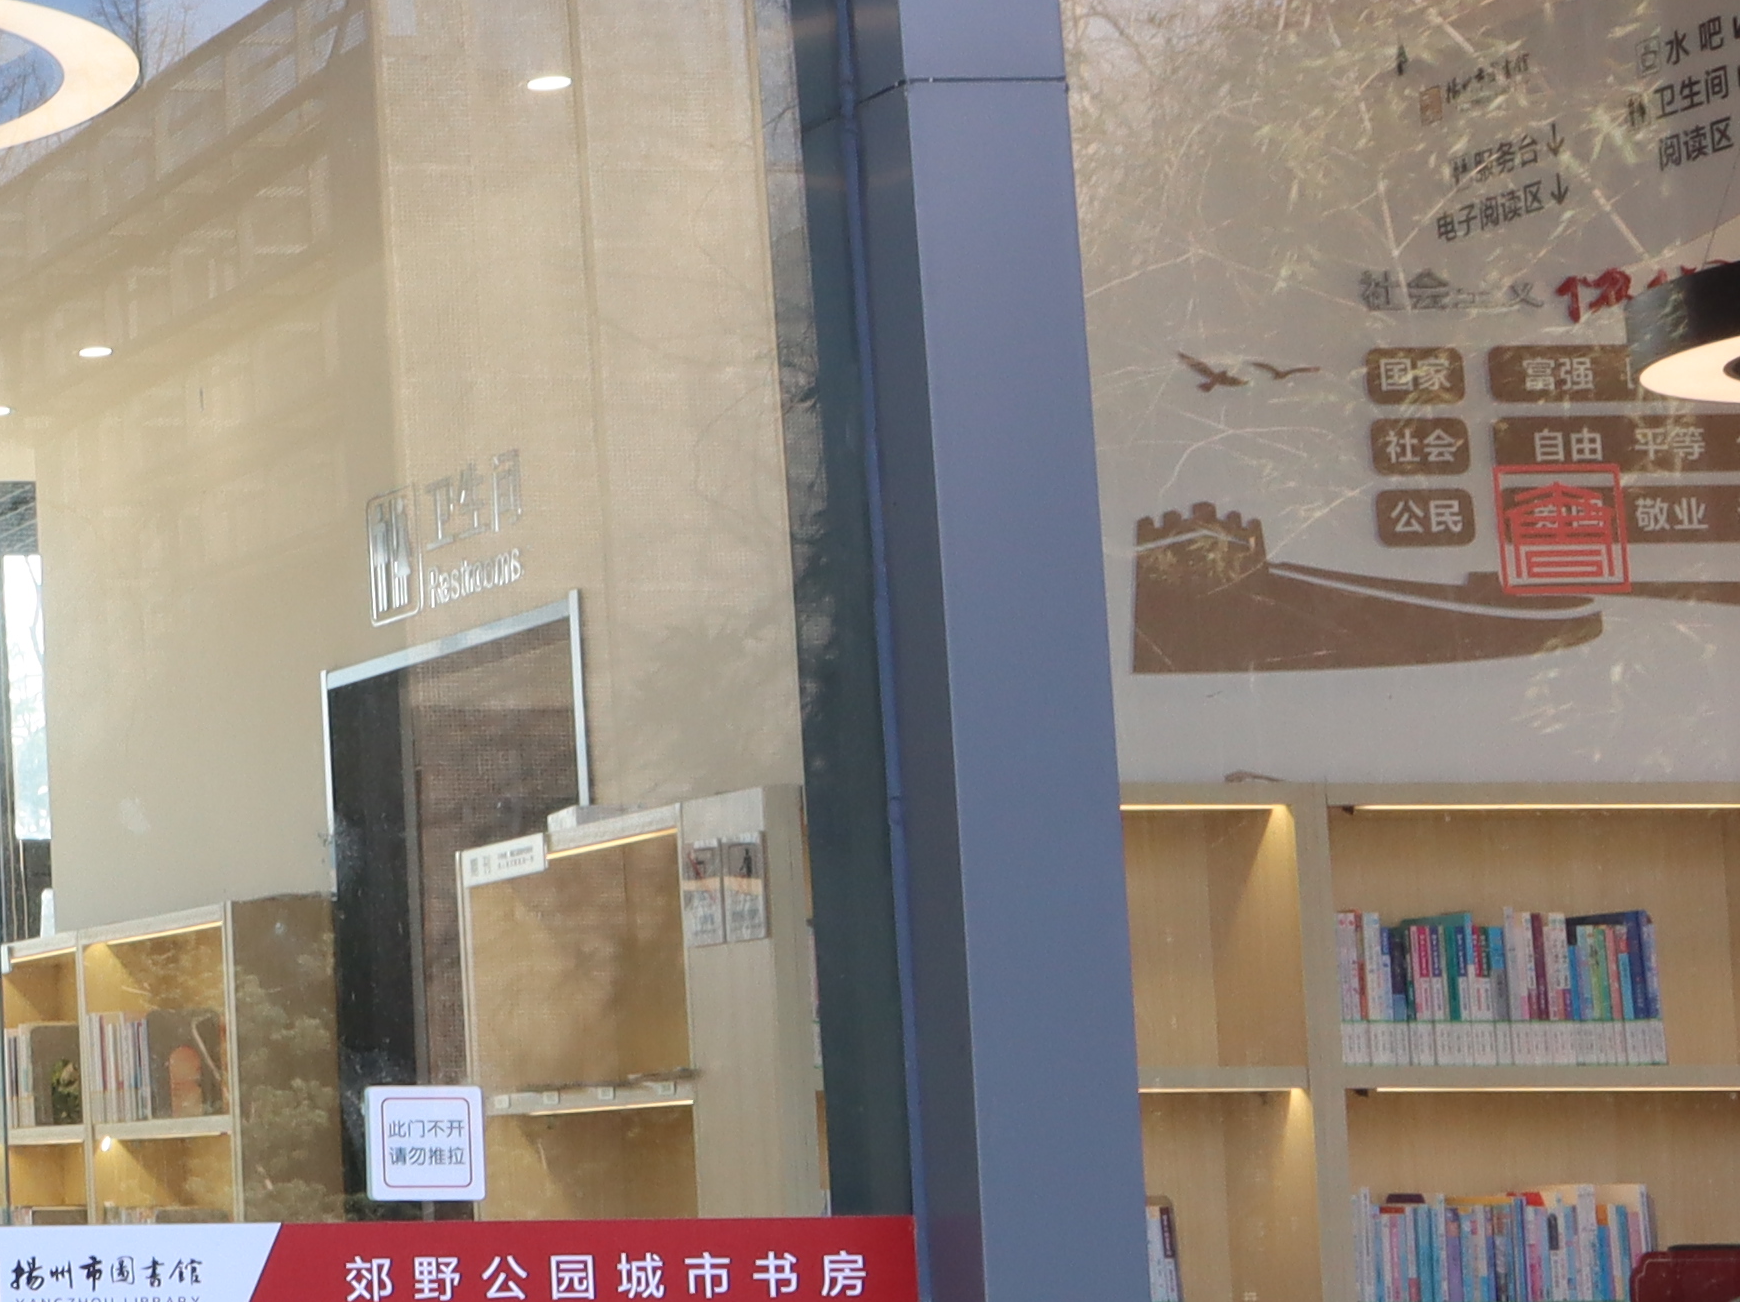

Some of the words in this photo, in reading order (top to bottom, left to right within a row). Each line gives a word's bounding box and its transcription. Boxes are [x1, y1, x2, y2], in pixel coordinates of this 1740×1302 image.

[1653, 65, 1730, 120] 卫生间
[1659, 116, 1734, 172] 阅读区
[1436, 179, 1545, 242] 电子阅读区
[1380, 357, 1452, 393] 国家
[1522, 357, 1595, 392] 富强
[1385, 429, 1459, 464] 社会
[1533, 428, 1604, 463] 自由
[1635, 426, 1706, 460] 平等
[1390, 500, 1464, 535] 公民
[1635, 497, 1709, 532] 敬业
[386, 1118, 465, 1141] 此门不开
[388, 1144, 467, 1168] 请勿推拉
[345, 1251, 868, 1302] 郊野公园城市书房
